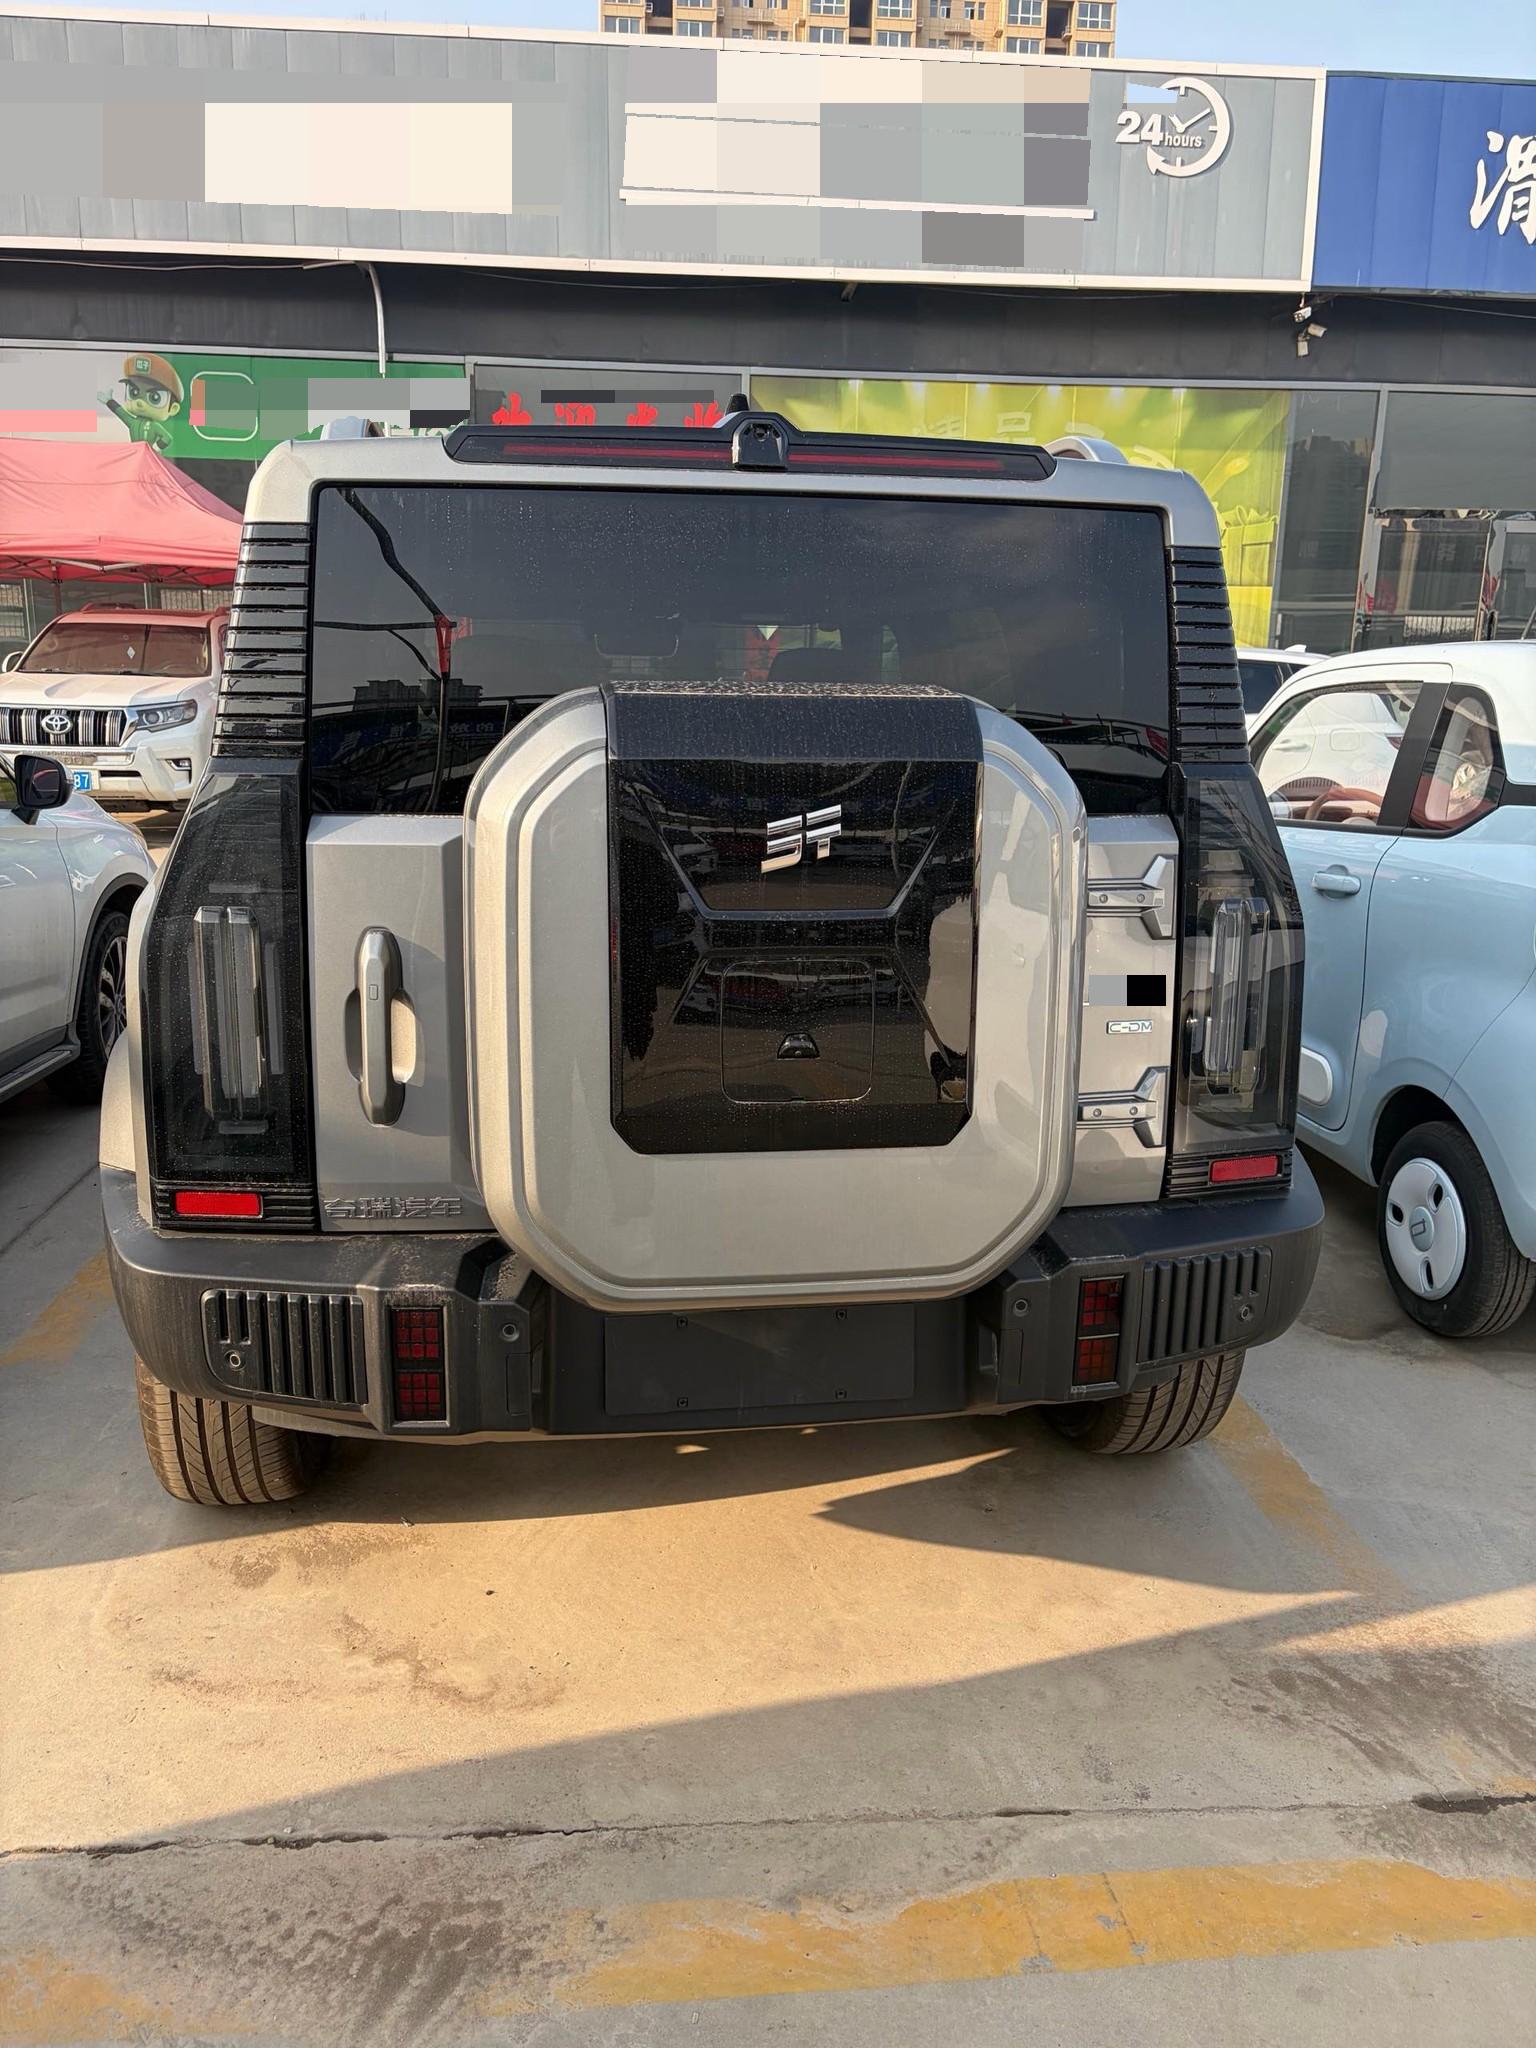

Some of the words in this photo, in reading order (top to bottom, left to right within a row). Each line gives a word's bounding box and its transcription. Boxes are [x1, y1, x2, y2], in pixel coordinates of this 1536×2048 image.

[1115, 110, 1164, 146] 24
[1164, 132, 1202, 148] hours
[1109, 1021, 1153, 1033] C-DM
[323, 1196, 461, 1218] 奇瑞汽车
